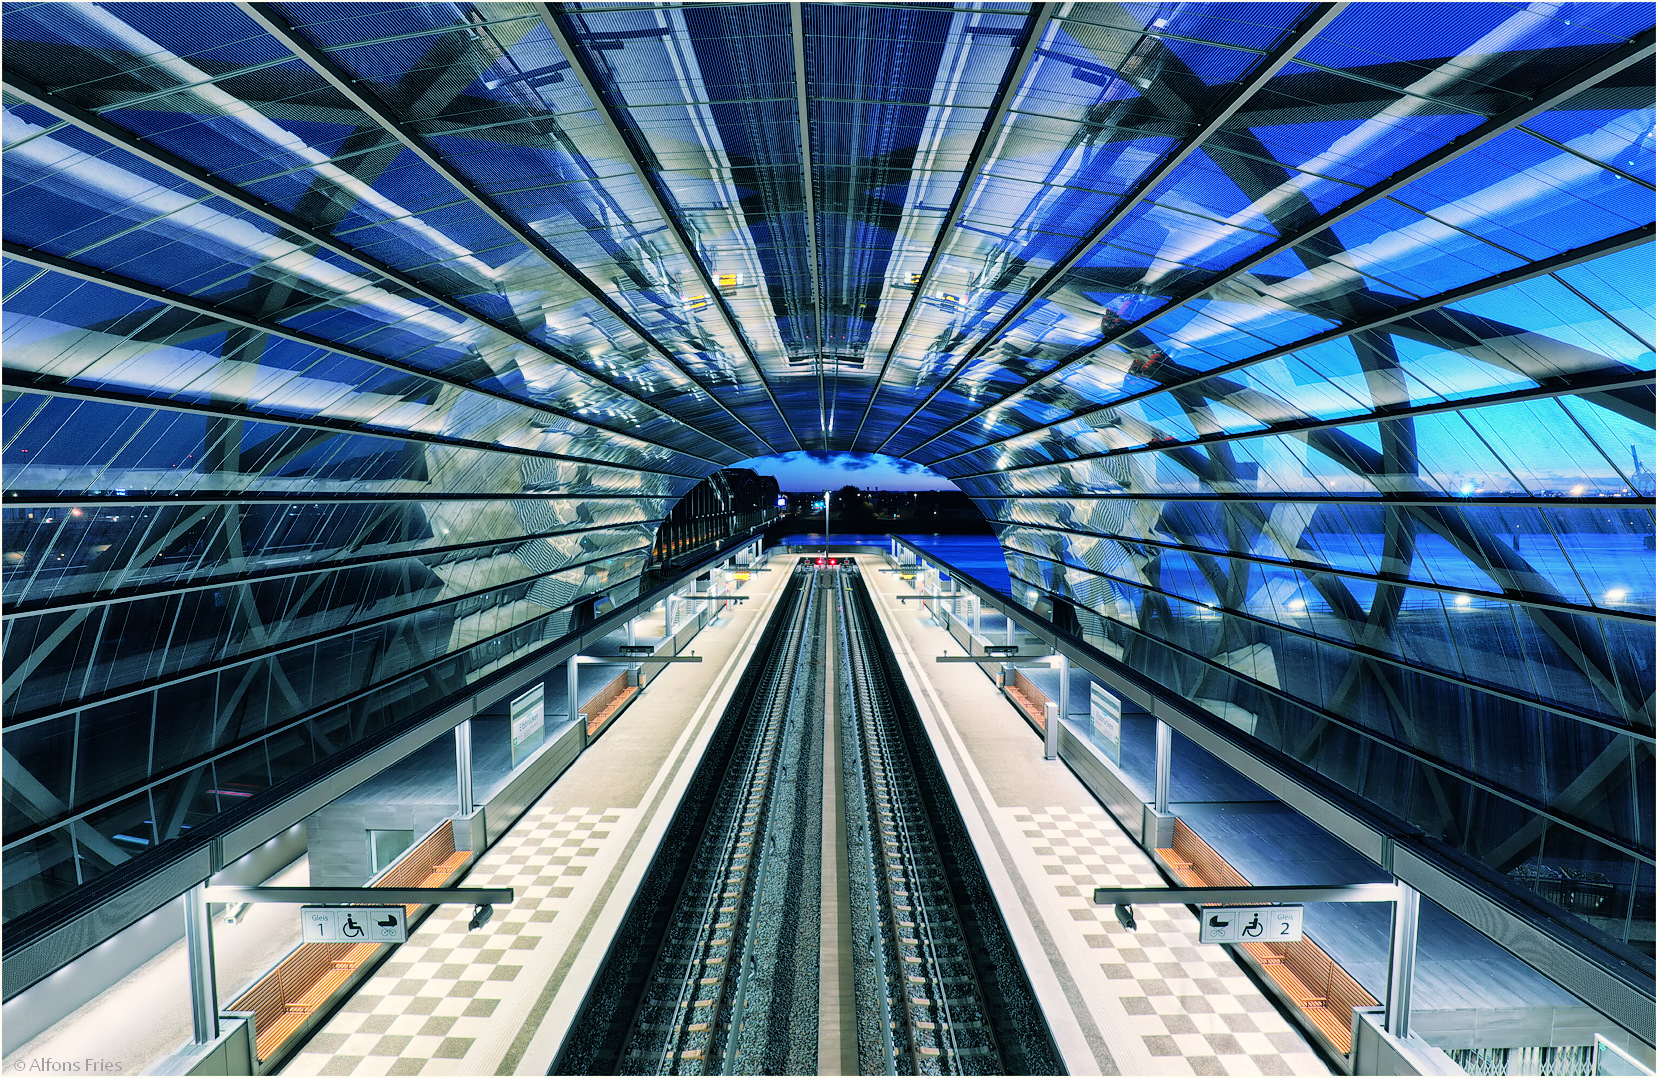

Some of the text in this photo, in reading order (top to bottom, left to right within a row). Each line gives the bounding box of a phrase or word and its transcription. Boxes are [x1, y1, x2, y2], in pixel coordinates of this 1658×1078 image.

[311, 914, 329, 922] Gleis
[1277, 913, 1294, 921] Gleis
[317, 923, 324, 937] 1
[1280, 922, 1290, 935] 2
